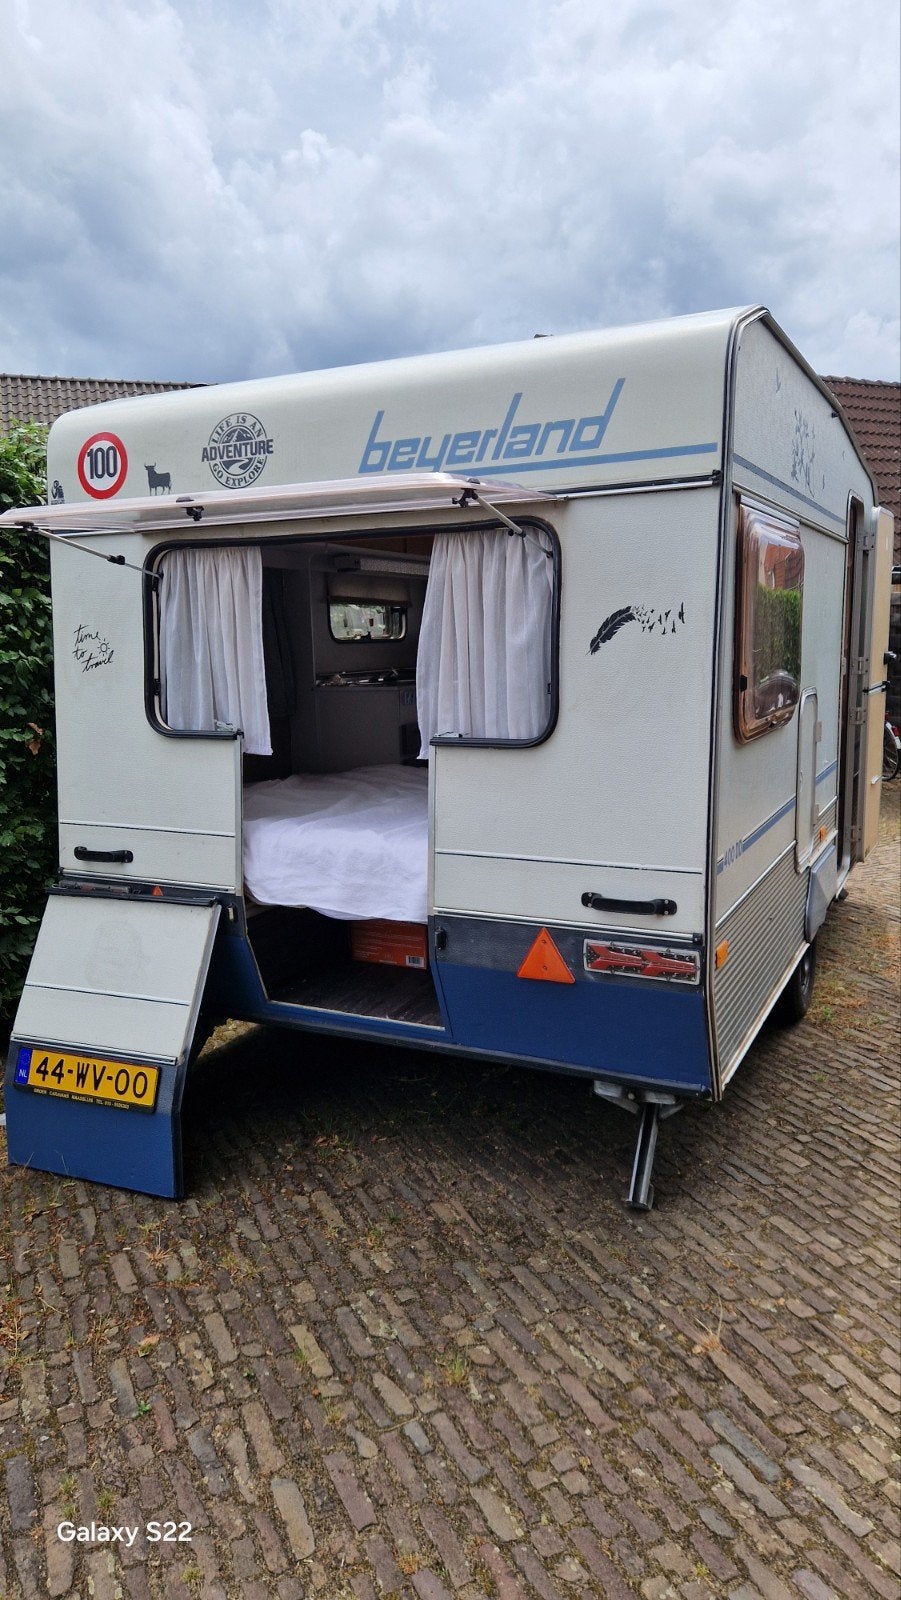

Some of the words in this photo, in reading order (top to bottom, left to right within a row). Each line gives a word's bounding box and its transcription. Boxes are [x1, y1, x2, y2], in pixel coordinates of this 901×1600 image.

[212, 418, 232, 444] LIFE
[236, 415, 247, 424] IS
[249, 421, 264, 438] AN
[358, 377, 626, 472] beyerland
[87, 445, 118, 480] 100
[201, 438, 274, 462] ADVENTURE
[212, 463, 224, 479] GO
[225, 458, 265, 487] EXPLORE
[18, 1068, 28, 1078] NL
[35, 1056, 148, 1099] 44-WV-00
